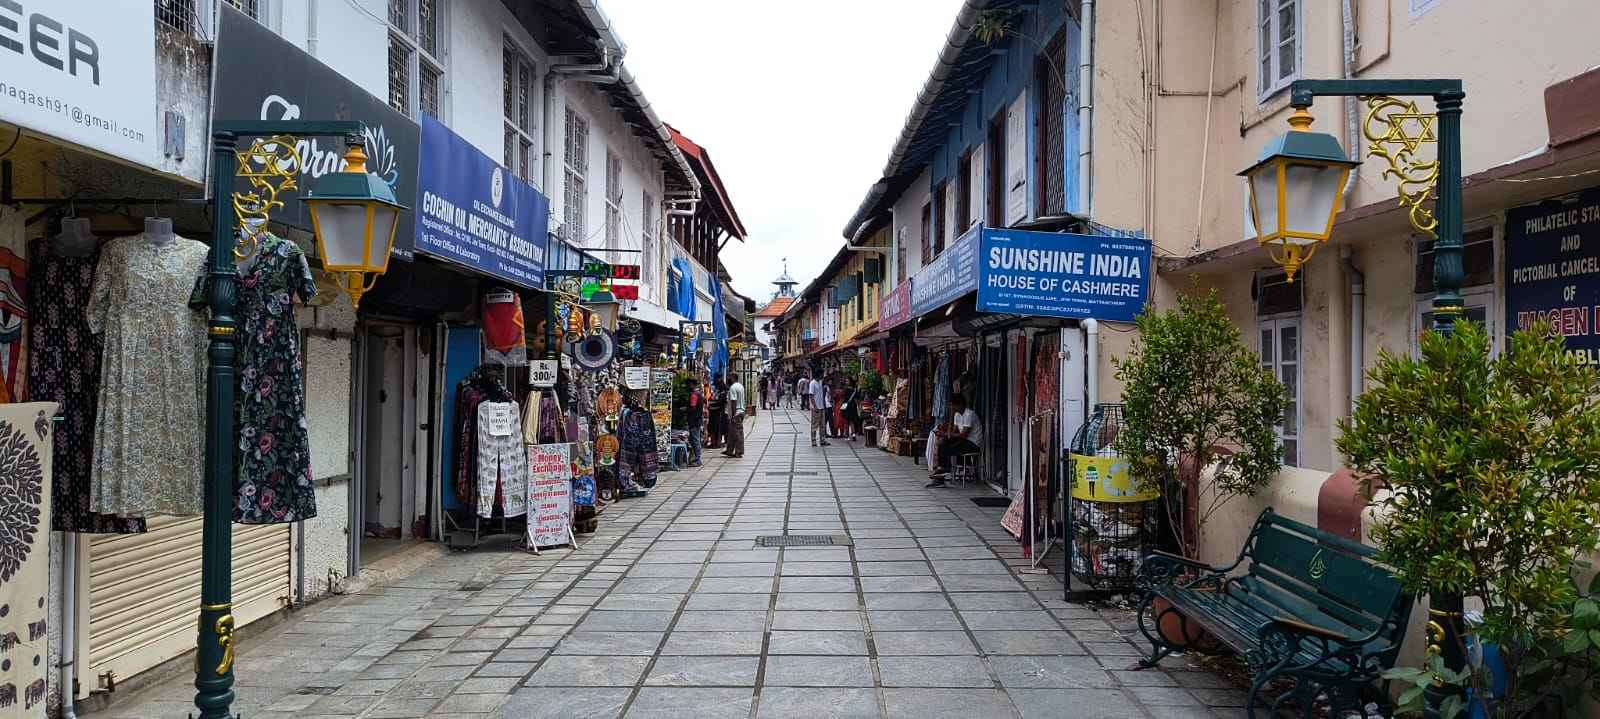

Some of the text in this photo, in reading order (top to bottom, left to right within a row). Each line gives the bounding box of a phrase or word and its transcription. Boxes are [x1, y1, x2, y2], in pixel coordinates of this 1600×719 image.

[423, 191, 454, 225] COCHIN
[455, 207, 466, 231] OIL
[509, 234, 543, 263] ASSOCIATION
[1525, 210, 1578, 236] PHILATELIC
[421, 232, 429, 243] 1st
[430, 234, 442, 248] Floor
[443, 239, 455, 252] Office
[1561, 235, 1580, 252] AND
[989, 246, 1085, 276] SUNSHINE
[1089, 253, 1141, 279] INDIA
[1513, 257, 1600, 284] PICTORIAL CANCEL
[988, 273, 1140, 297] HOUSE OF CASHMERE
[1563, 286, 1576, 302] OF
[533, 371, 555, 382] 300/-
[533, 463, 566, 474] Exchange
[538, 454, 561, 464] Money
